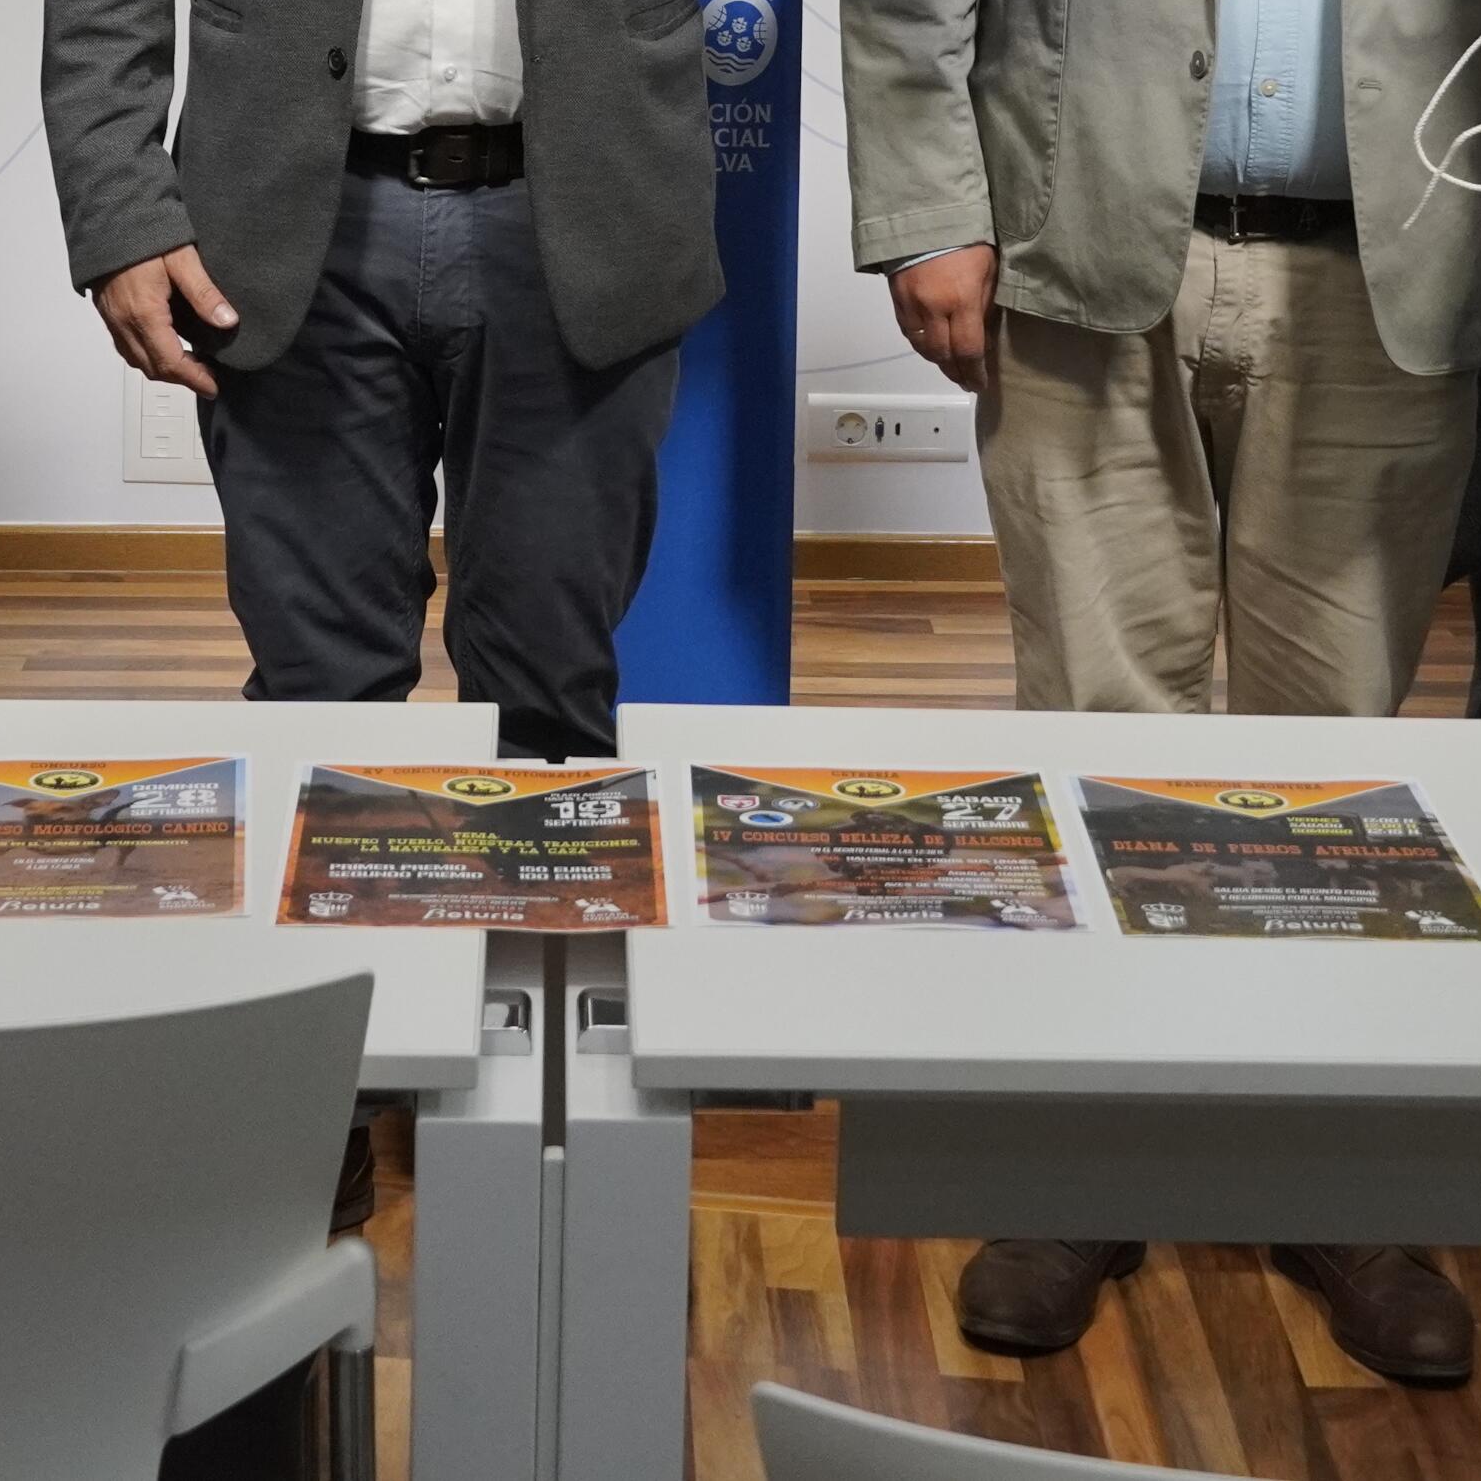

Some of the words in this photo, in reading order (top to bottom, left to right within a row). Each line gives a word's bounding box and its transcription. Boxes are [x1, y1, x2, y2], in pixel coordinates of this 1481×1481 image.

[132, 782, 220, 791] DOMINGO
[128, 789, 218, 809] 28
[936, 794, 1024, 805] SÁBADO
[129, 807, 219, 817] SEPTIEMBRE
[550, 799, 623, 820] 19
[941, 803, 1022, 822] 27
[32, 822, 153, 836] MORFOLÓGICO
[162, 821, 231, 834] CANINO
[543, 817, 631, 828] SEPTIEMBRE
[942, 820, 1030, 830] SEPTIEMBRE
[311, 836, 380, 846] NUESTRO
[454, 838, 535, 848] NUESTRAS
[712, 830, 734, 842] IV
[741, 830, 832, 844] CONCURSO
[838, 831, 916, 845] BELLEZA
[923, 834, 945, 845] DE
[954, 835, 1045, 848] HALCONES
[359, 844, 381, 853] LA
[388, 844, 491, 854] NATURALEZA
[518, 846, 540, 855] LA
[1111, 840, 1181, 852] DIANA
[1190, 841, 1217, 853] DE
[1226, 842, 1303, 855] PERROS
[1314, 844, 1440, 858] ATRILLADOS
[329, 862, 397, 872] PRIMER
[400, 863, 469, 872] PREMIO
[552, 864, 613, 874] EUROS
[328, 870, 412, 880] SEGUNDO
[416, 871, 485, 880] PREMIO
[518, 872, 550, 881] 100
[553, 872, 614, 882] EUROS
